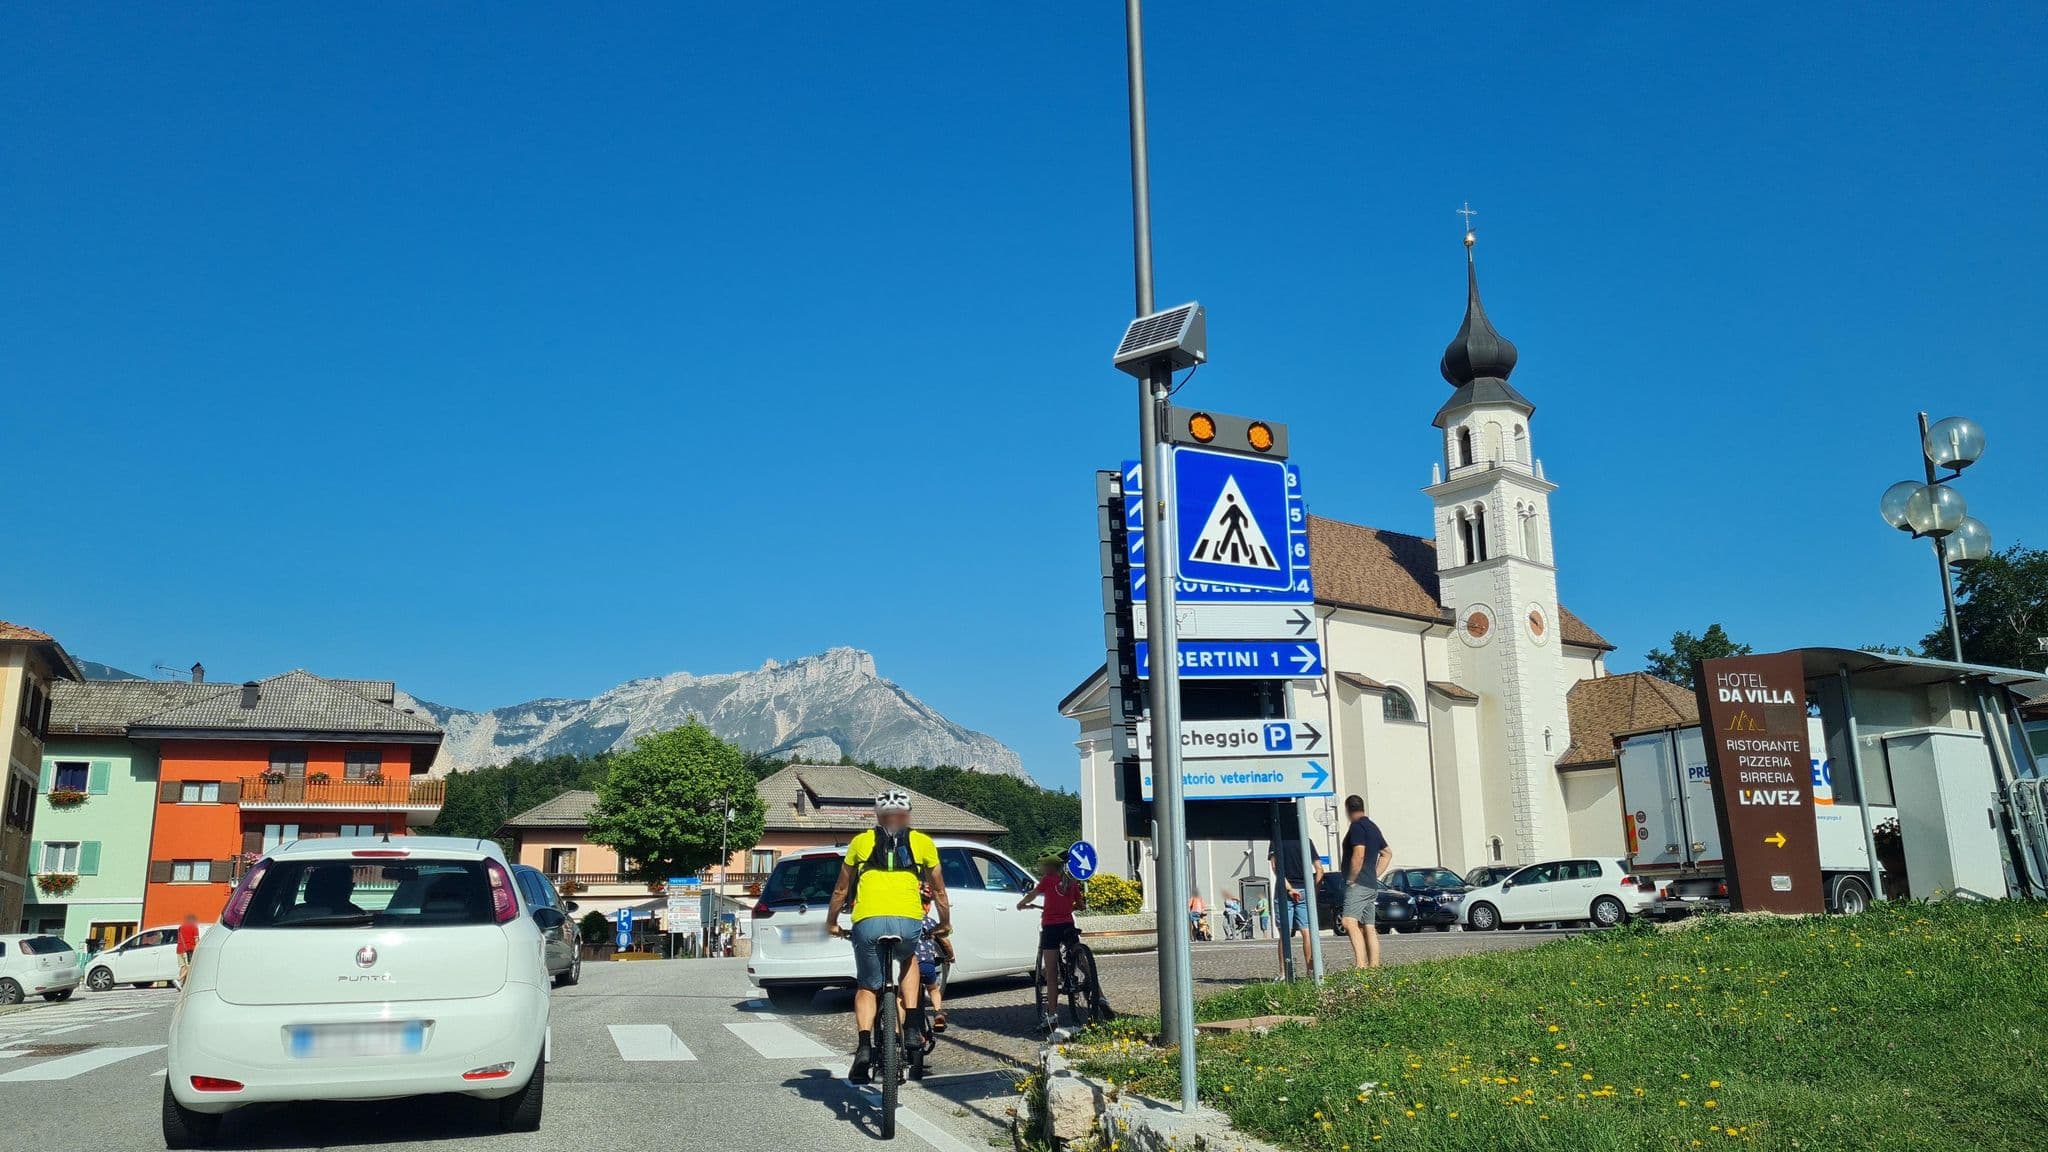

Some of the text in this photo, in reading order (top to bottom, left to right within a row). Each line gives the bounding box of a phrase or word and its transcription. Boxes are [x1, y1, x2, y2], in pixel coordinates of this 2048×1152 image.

[1290, 508, 1302, 522] 5
[1290, 543, 1306, 557] 6
[1143, 651, 1279, 668] BERTINI 1
[1717, 672, 1768, 689] HOTEL
[1718, 688, 1795, 704] DA VILLA
[1146, 729, 1259, 750] pcheggio
[1727, 739, 1801, 753] RISTORANTE
[1739, 755, 1792, 768] PIZZERIA
[1220, 770, 1284, 784] veterinario
[1740, 771, 1795, 784] BIRRERIA
[1739, 789, 1801, 806] L'AVEZ
